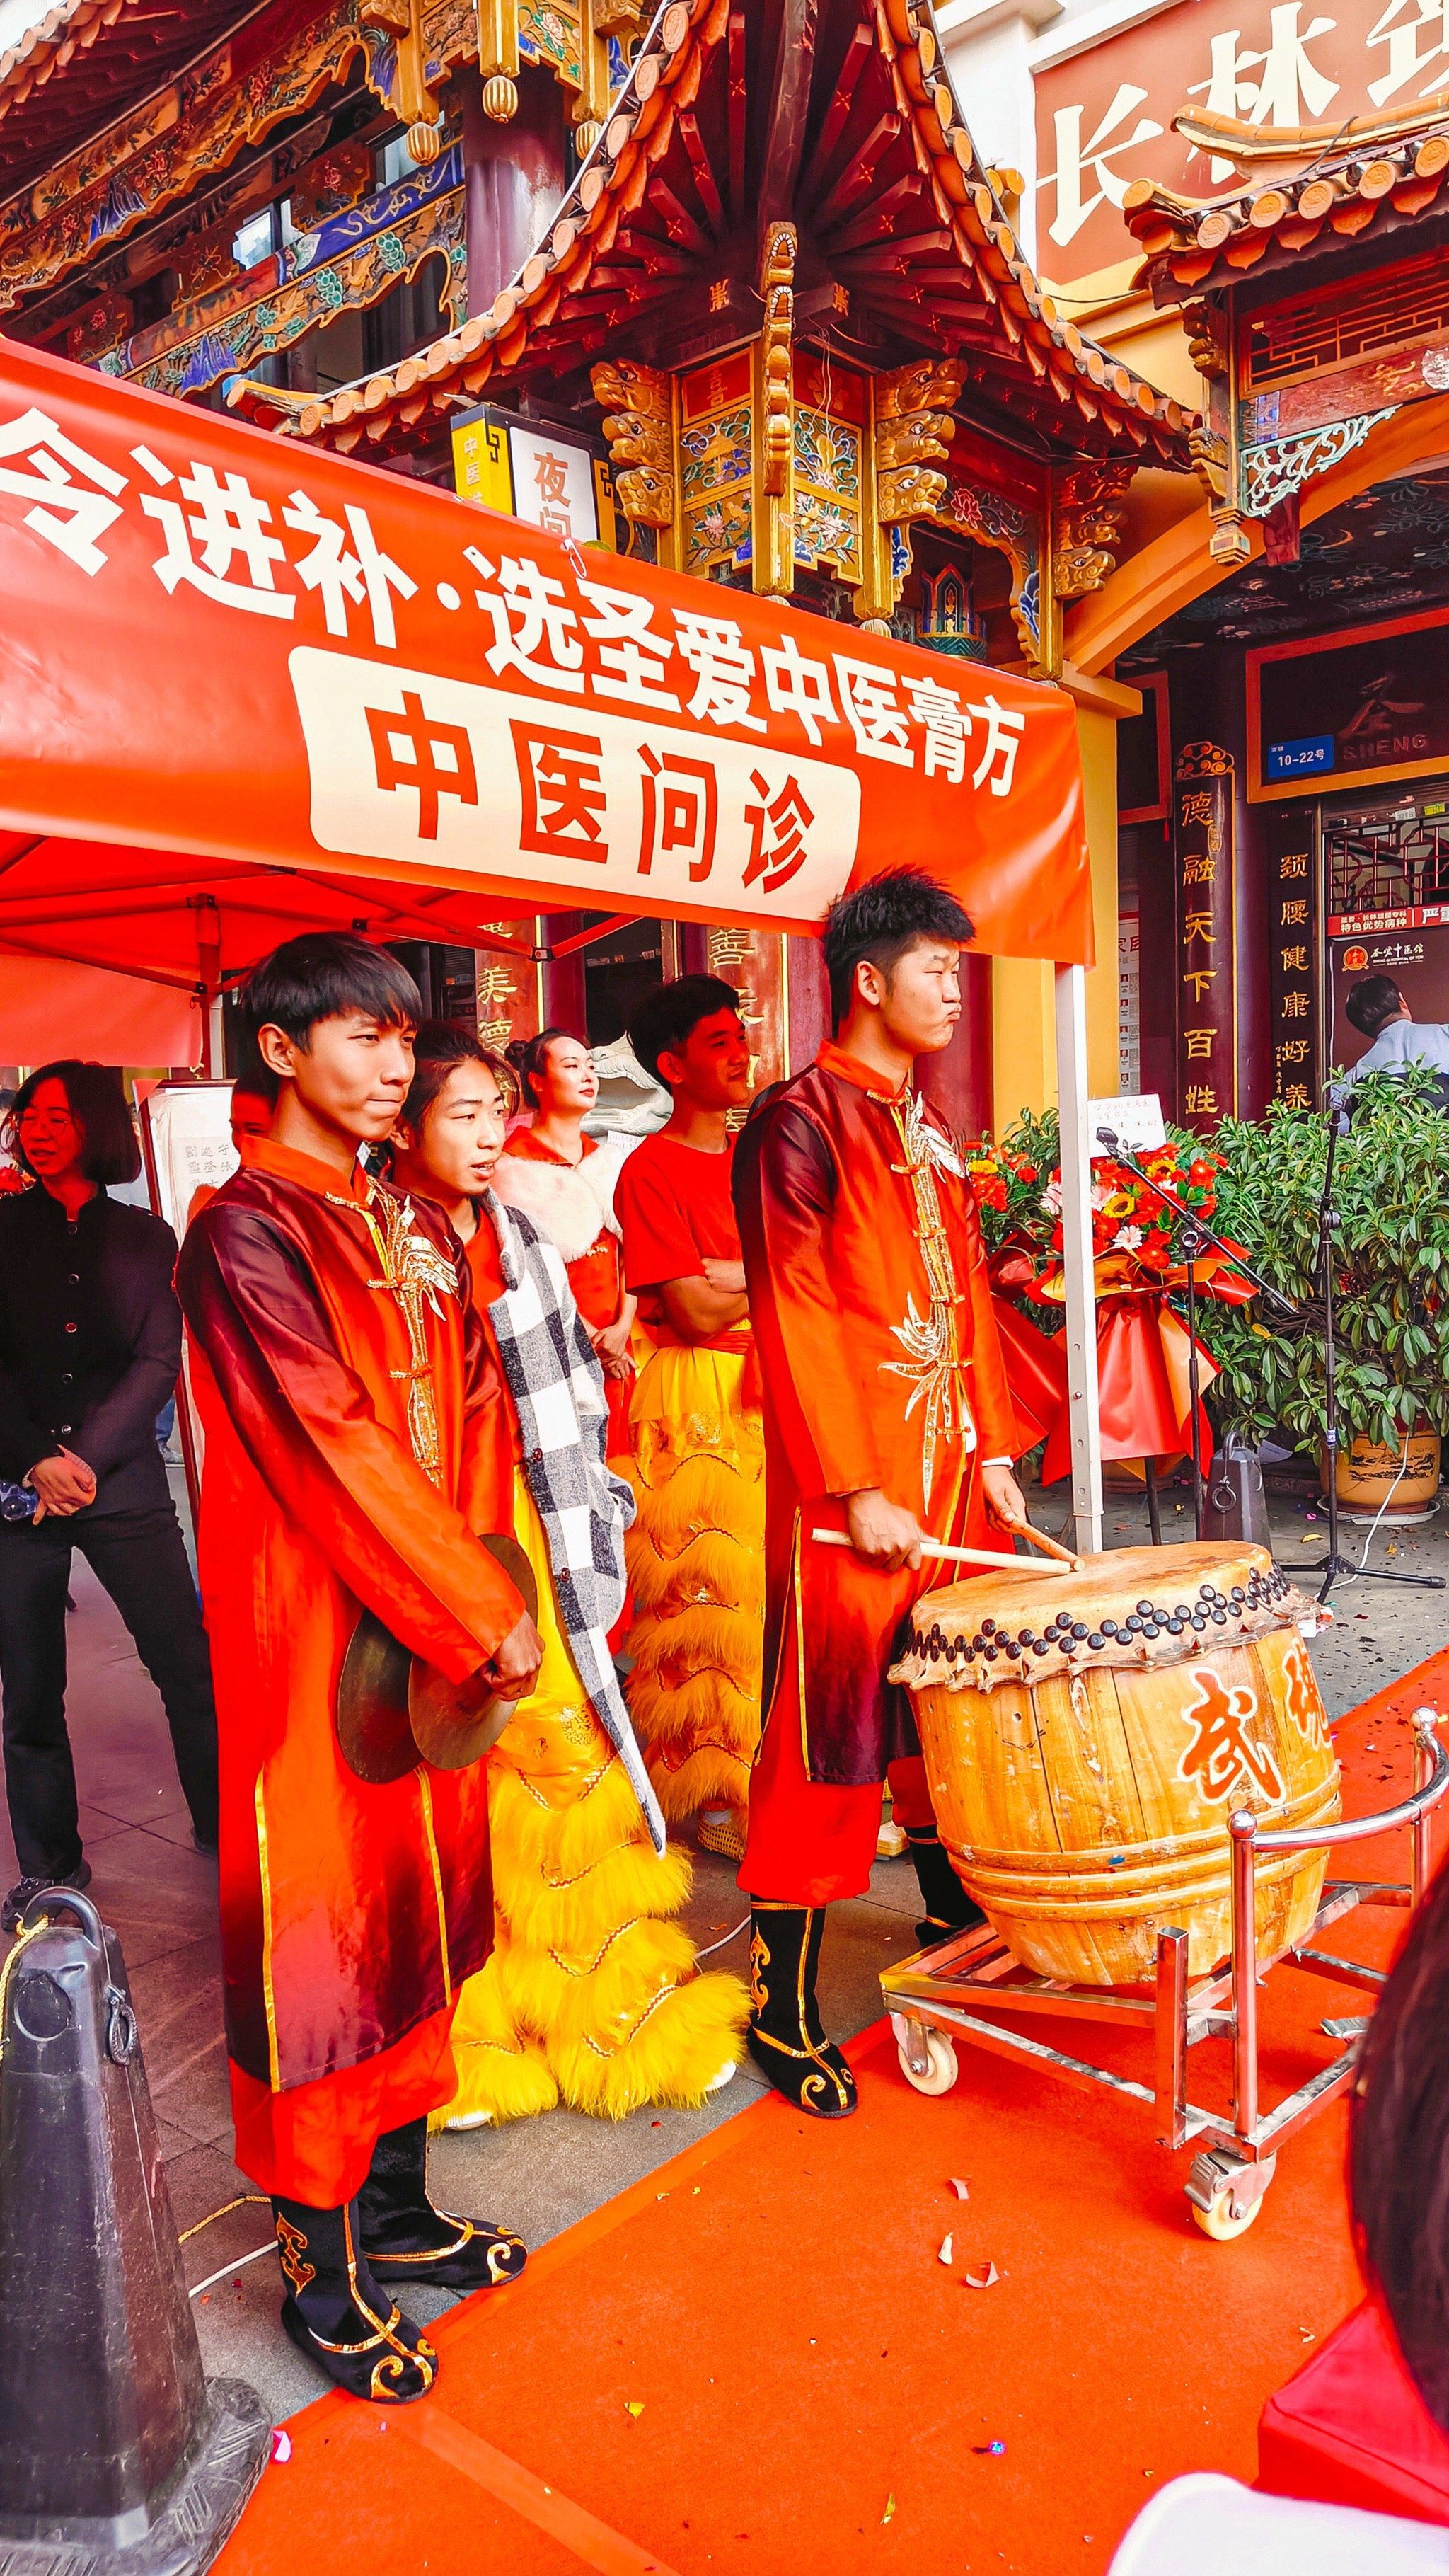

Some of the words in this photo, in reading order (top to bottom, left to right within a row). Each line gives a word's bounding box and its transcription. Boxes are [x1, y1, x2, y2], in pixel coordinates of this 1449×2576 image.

[1278, 749, 1325, 766] 10-22号
[1344, 734, 1426, 761] SHENG
[364, 691, 814, 893] 中医问诊
[1341, 918, 1407, 933] 特色优势病种
[1182, 791, 1219, 1115] 德融天下百姓
